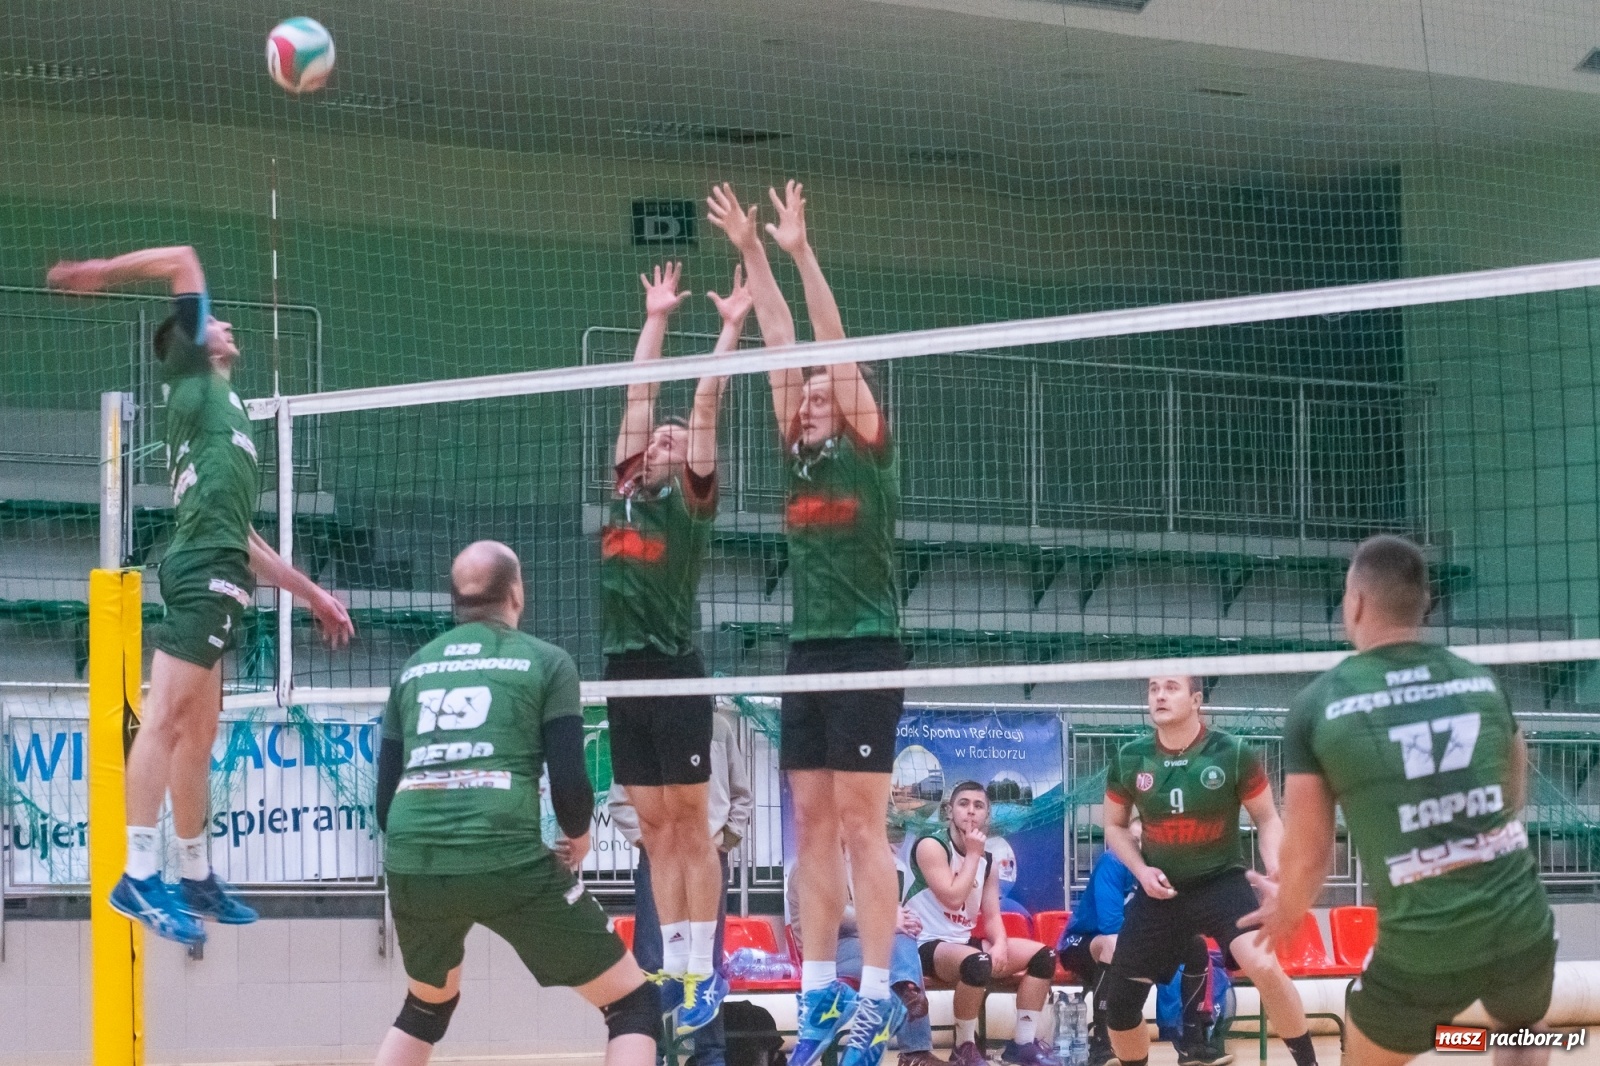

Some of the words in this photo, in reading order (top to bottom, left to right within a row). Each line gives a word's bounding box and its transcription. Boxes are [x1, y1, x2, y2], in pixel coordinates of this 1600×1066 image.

[644, 216, 681, 240] D
[416, 686, 493, 735] 19
[922, 725, 961, 740] Sportu
[955, 748, 965, 758] w
[969, 746, 1026, 760] Raciborzu
[1388, 712, 1481, 780] 17
[1170, 788, 1184, 814] 9
